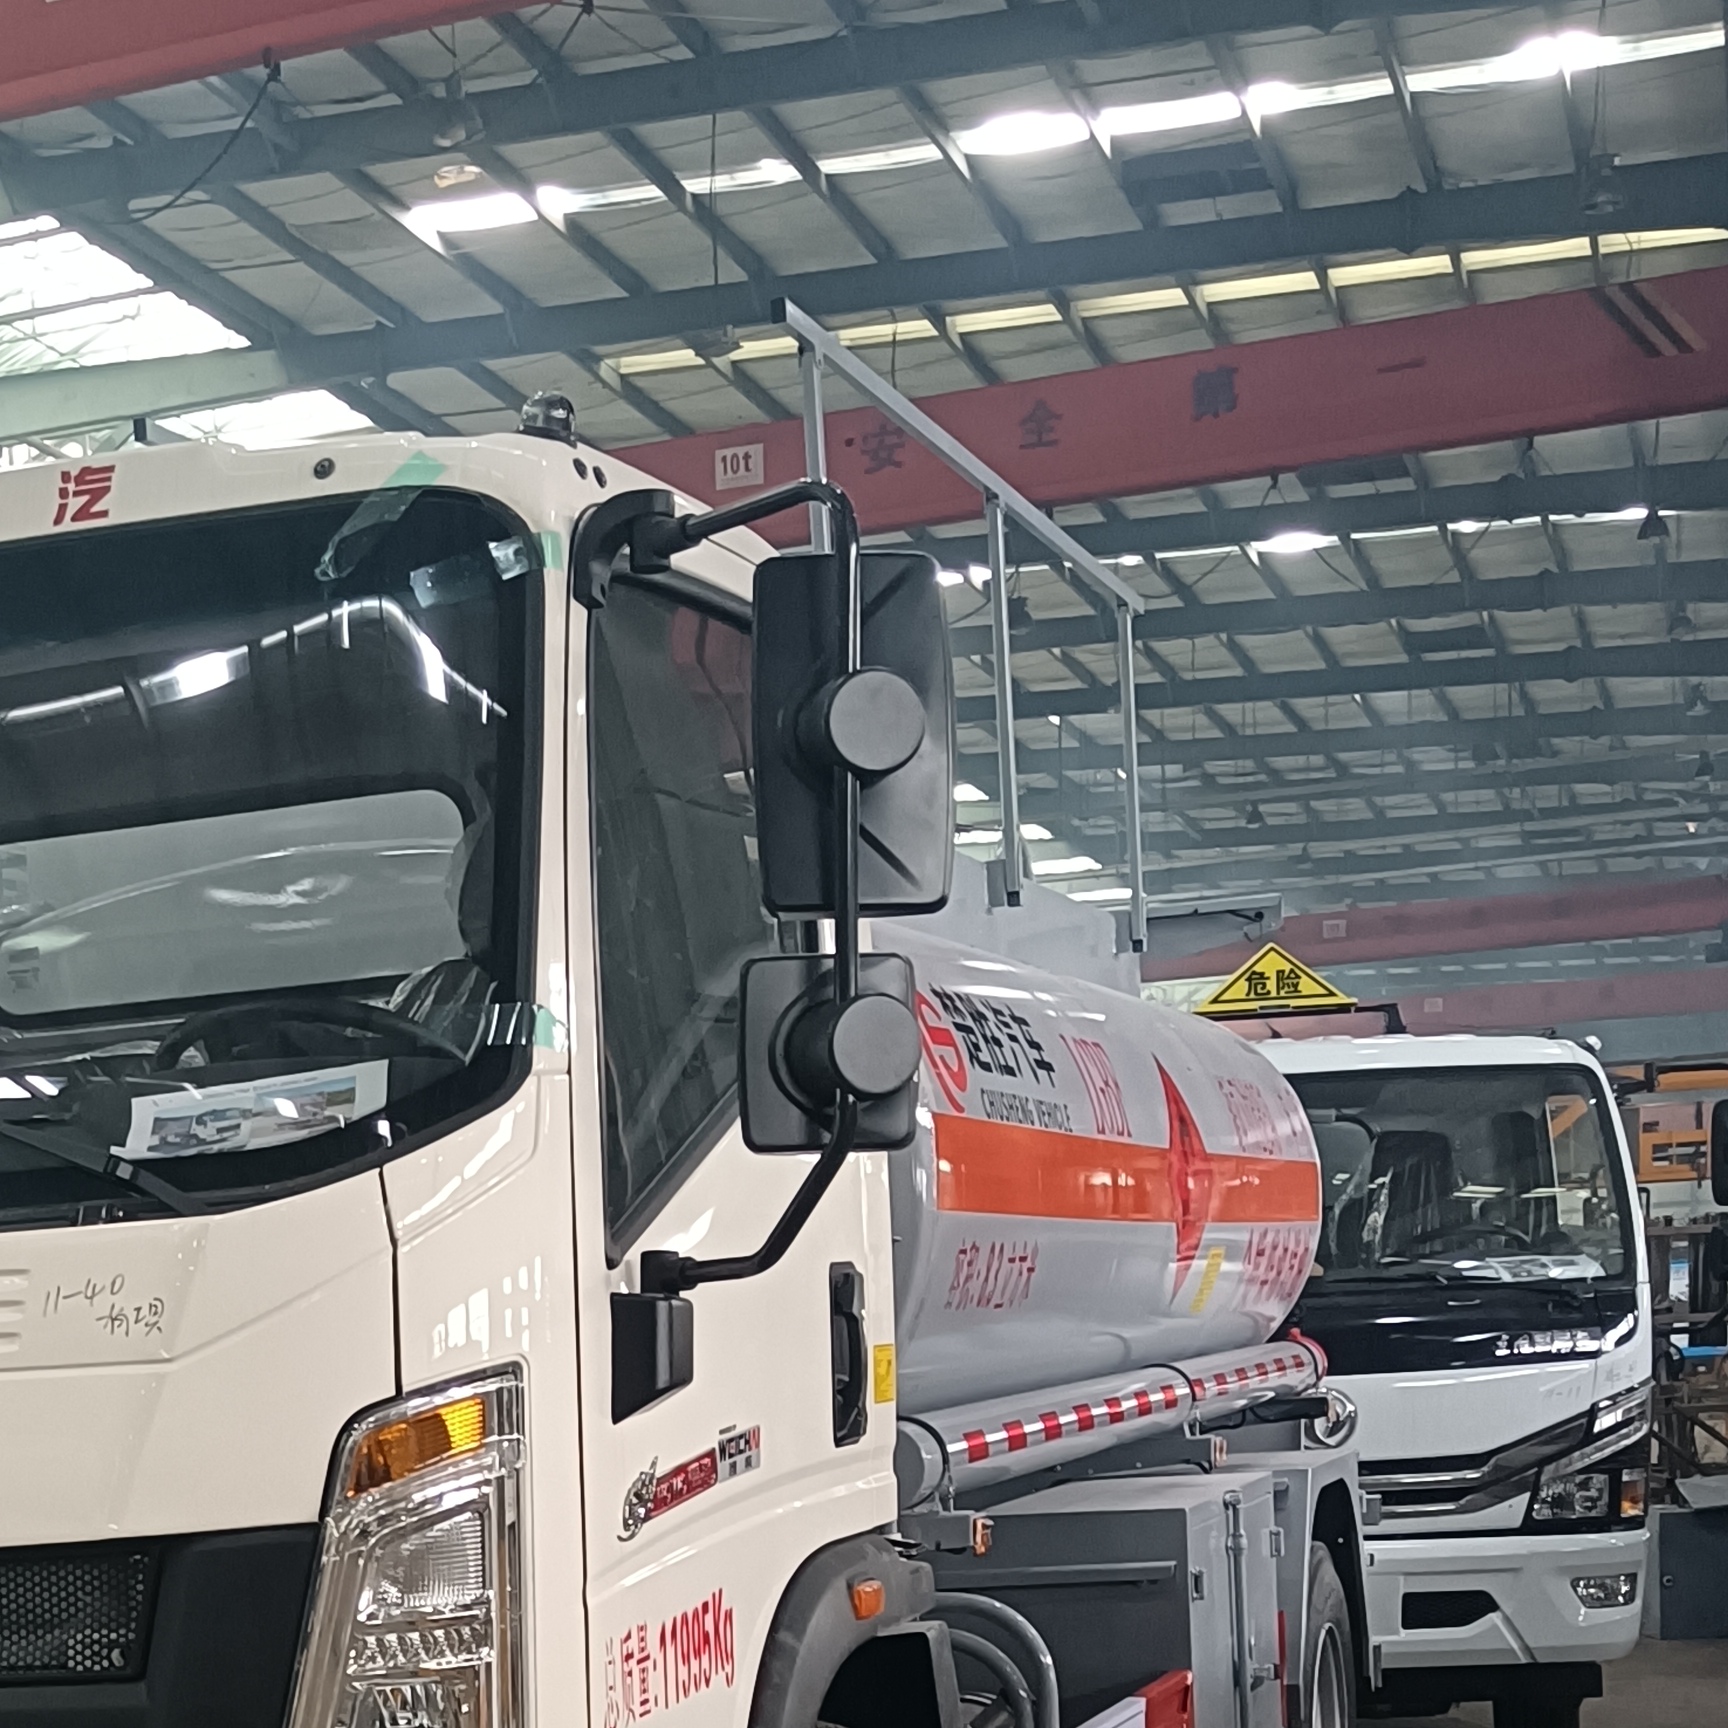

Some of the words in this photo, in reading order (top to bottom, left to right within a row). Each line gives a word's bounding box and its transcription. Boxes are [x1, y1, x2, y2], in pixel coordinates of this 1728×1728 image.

[720, 450, 753, 477] 10t
[1244, 951, 1303, 998] 危险
[928, 983, 1056, 1088] 楚胜汽车
[980, 1087, 1036, 1126] CHUSHENG
[1031, 1098, 1073, 1133] VEHICLE
